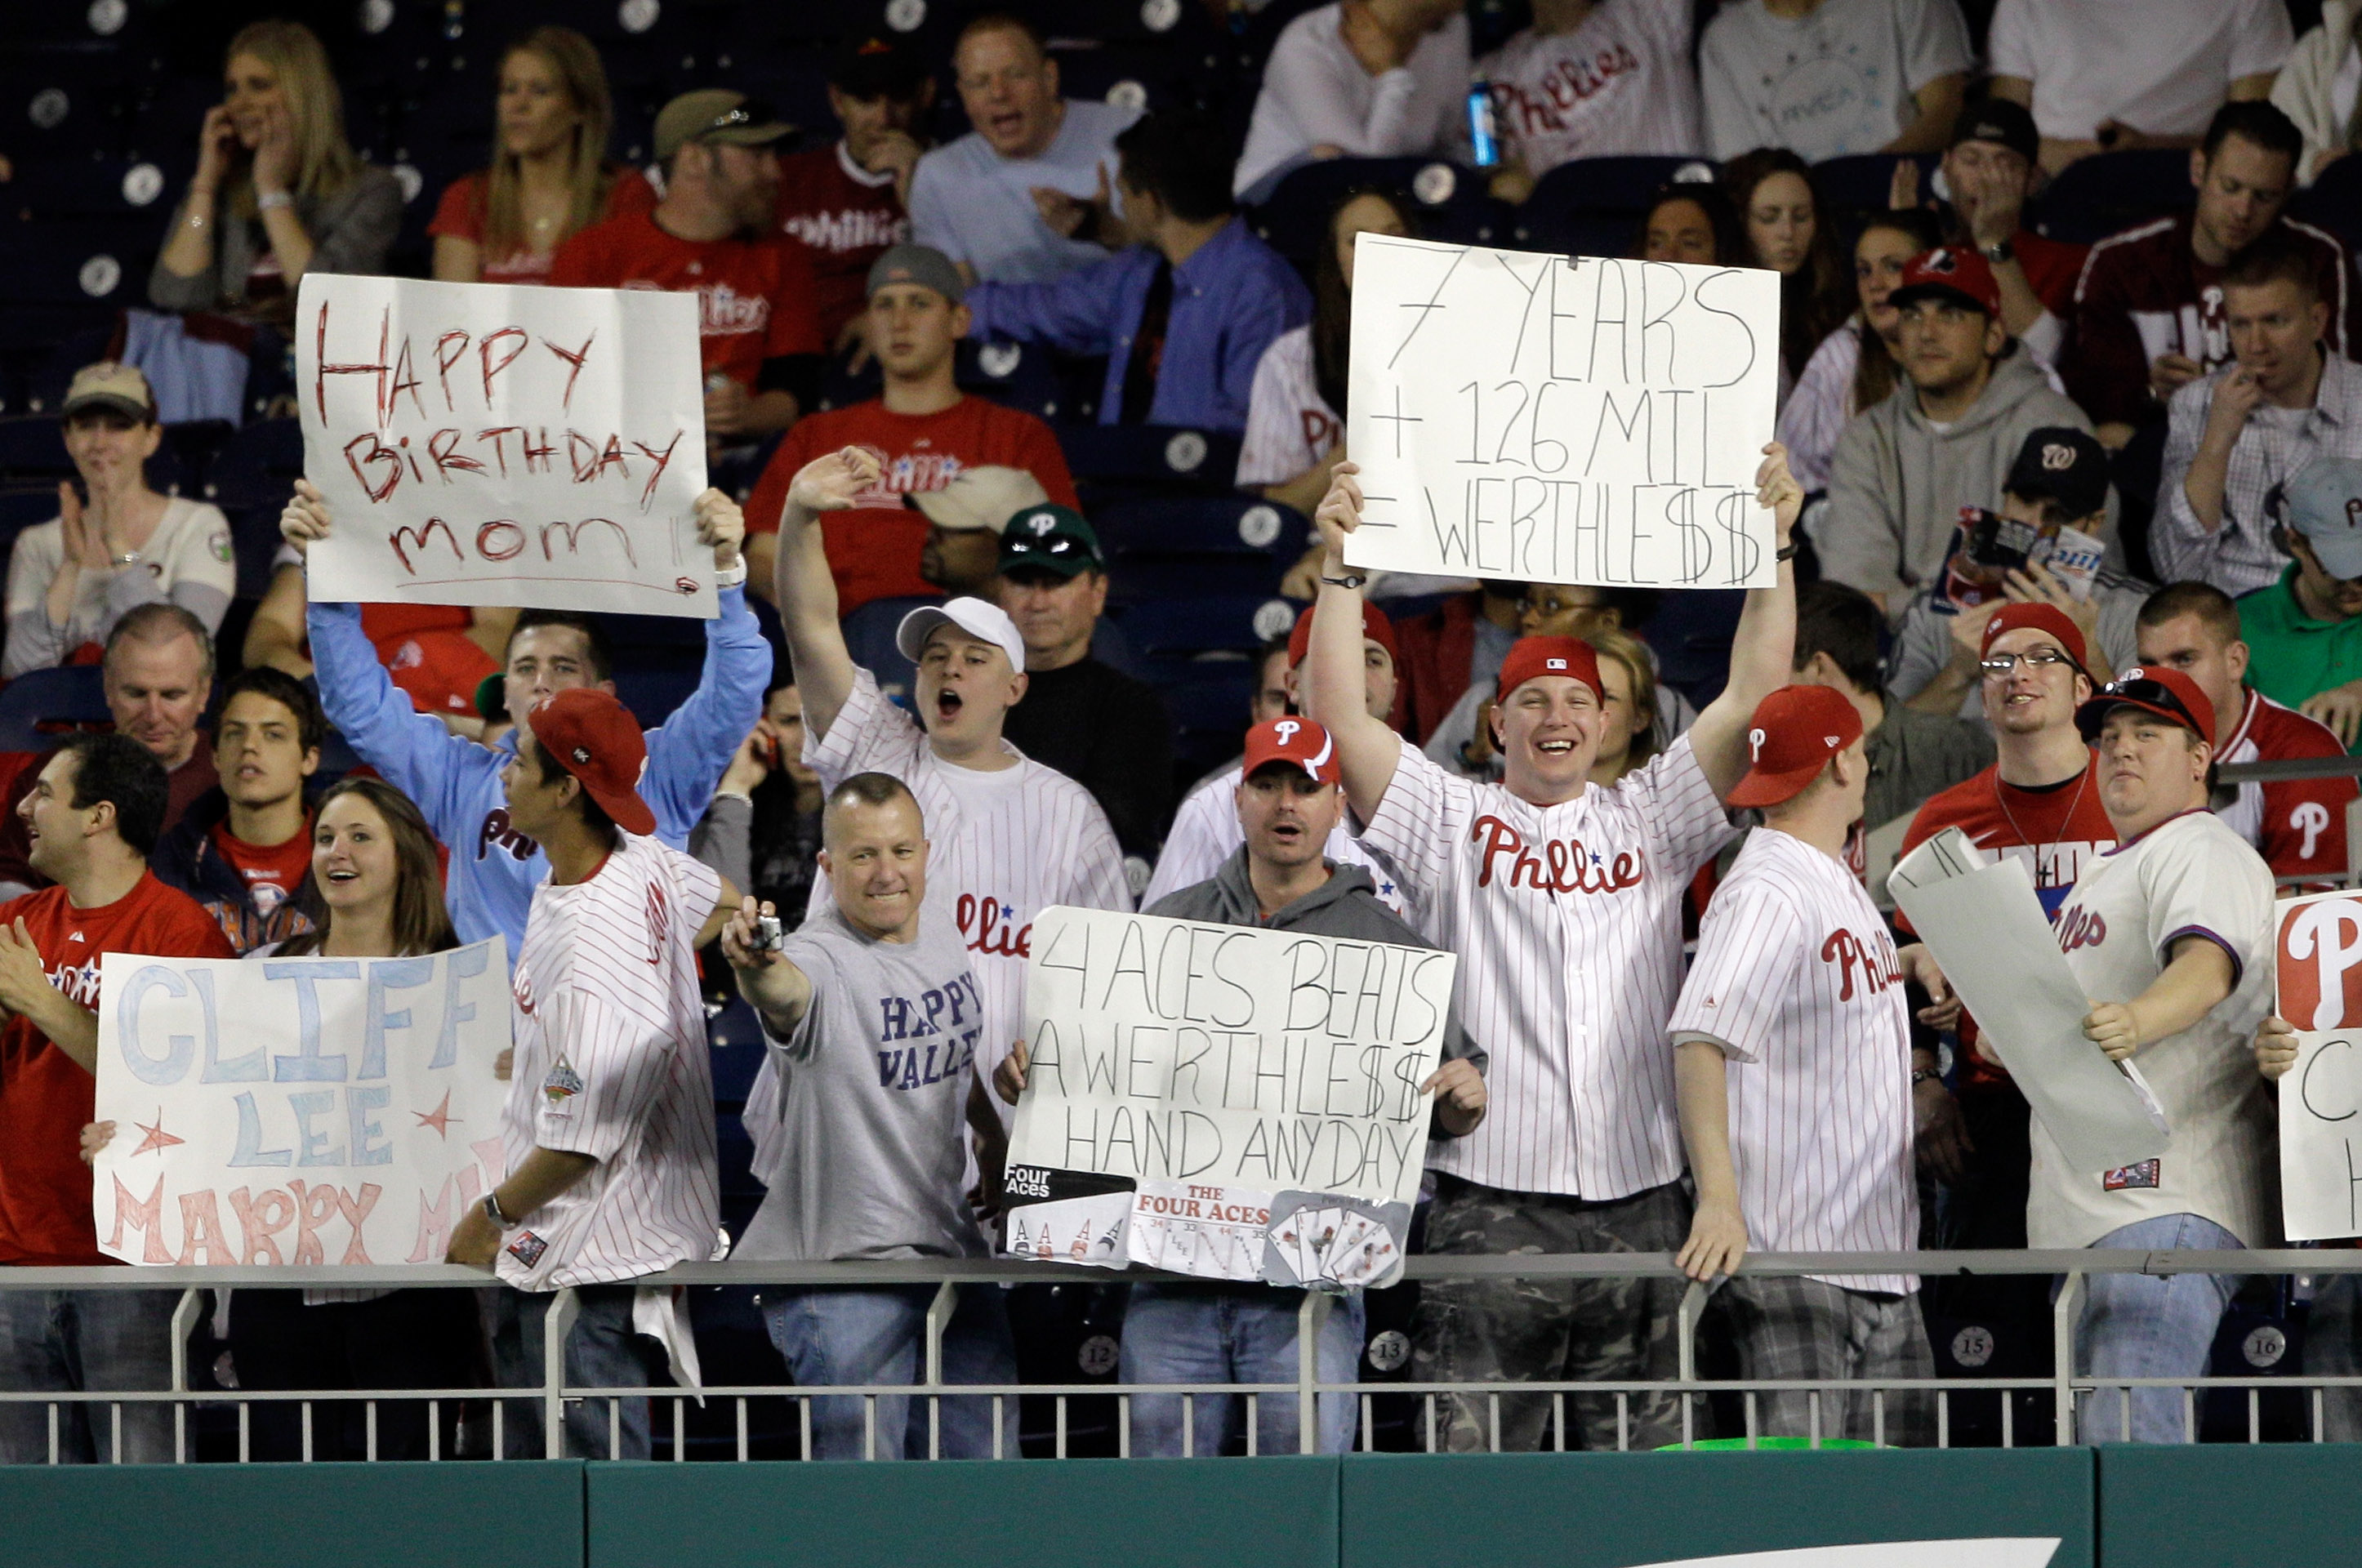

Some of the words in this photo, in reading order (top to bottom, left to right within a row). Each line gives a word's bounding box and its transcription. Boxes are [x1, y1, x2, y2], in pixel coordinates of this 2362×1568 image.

[1366, 240, 1468, 370] 7
[1495, 256, 1755, 389] YEARS
[315, 298, 599, 430] HAPPY
[1455, 380, 1568, 474] 126
[1584, 389, 1736, 488] MIL
[1424, 475, 1759, 585] WERTHLE$$
[1273, 720, 1301, 746] P
[1749, 728, 1766, 764] P
[2289, 801, 2329, 860] P
[116, 942, 490, 1085] CLIFF
[880, 970, 983, 1042] HAPPY
[1040, 923, 1090, 1009] 4
[1102, 920, 1258, 1028] ACES
[1282, 939, 1445, 1046] BEATS
[877, 1025, 983, 1091] VALLE
[1023, 1018, 1067, 1098] A
[1079, 1022, 1431, 1125] WERTHLE$$
[226, 1085, 393, 1169] LEE
[1064, 1106, 1223, 1178] HAND
[1003, 1164, 1051, 1185] Four
[1005, 1178, 1050, 1198] Aces
[1188, 1184, 1224, 1201] THE
[98, 1169, 383, 1266] MARRY
[1136, 1194, 1201, 1218] FOUR
[1206, 1202, 1270, 1226] ACES
[1171, 1235, 1188, 1256] LEE
[1088, 1347, 1110, 1364] 12
[1379, 1342, 1401, 1360] 13
[1961, 1339, 1984, 1355] 15
[2254, 1339, 2276, 1355] 16
